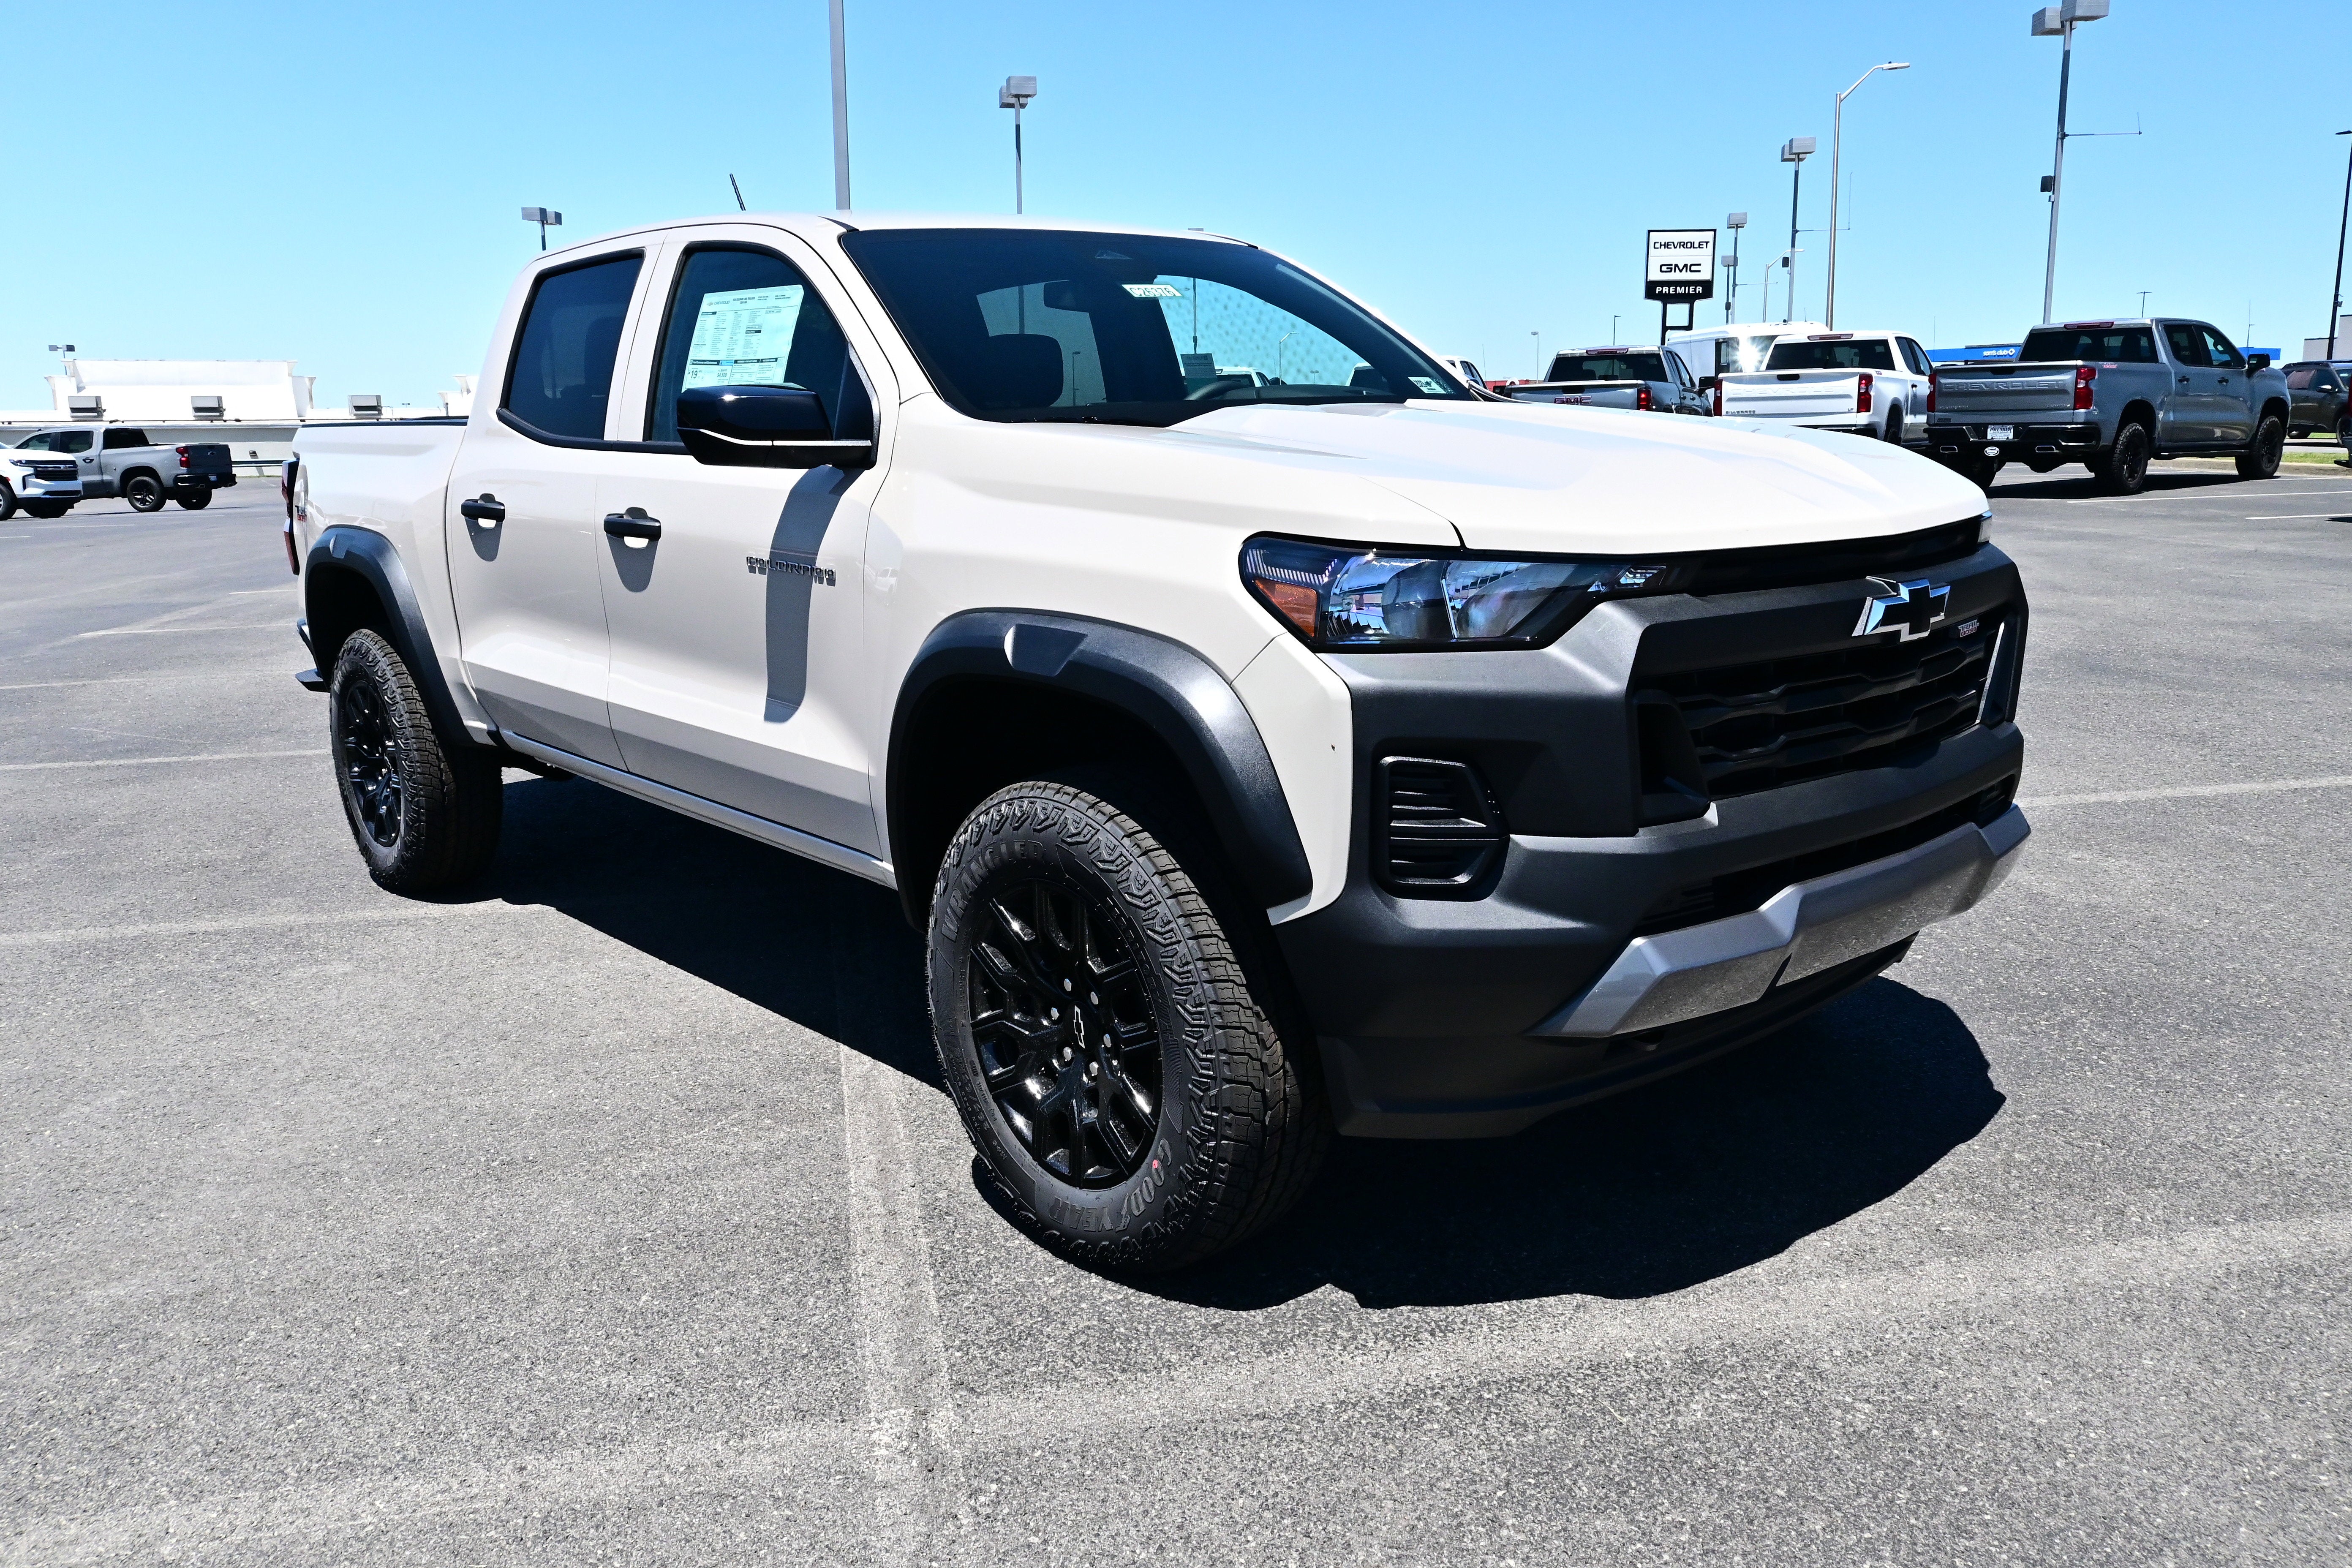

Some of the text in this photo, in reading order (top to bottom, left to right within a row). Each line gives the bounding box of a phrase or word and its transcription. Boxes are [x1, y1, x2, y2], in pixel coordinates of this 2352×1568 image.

[1653, 241, 1710, 249] CHEVROLET
[1659, 263, 1701, 273] GMC
[1130, 287, 1176, 297] C26376
[1656, 286, 1702, 294] PREMIER
[1731, 386, 1847, 395] CHEVROLET
[1942, 381, 2064, 391] CHEVROLET
[1554, 396, 1592, 404] GMC
[746, 556, 836, 580] COLORADO
[1958, 620, 1979, 632] TRAIL
[942, 839, 1047, 942] WRANGLER
